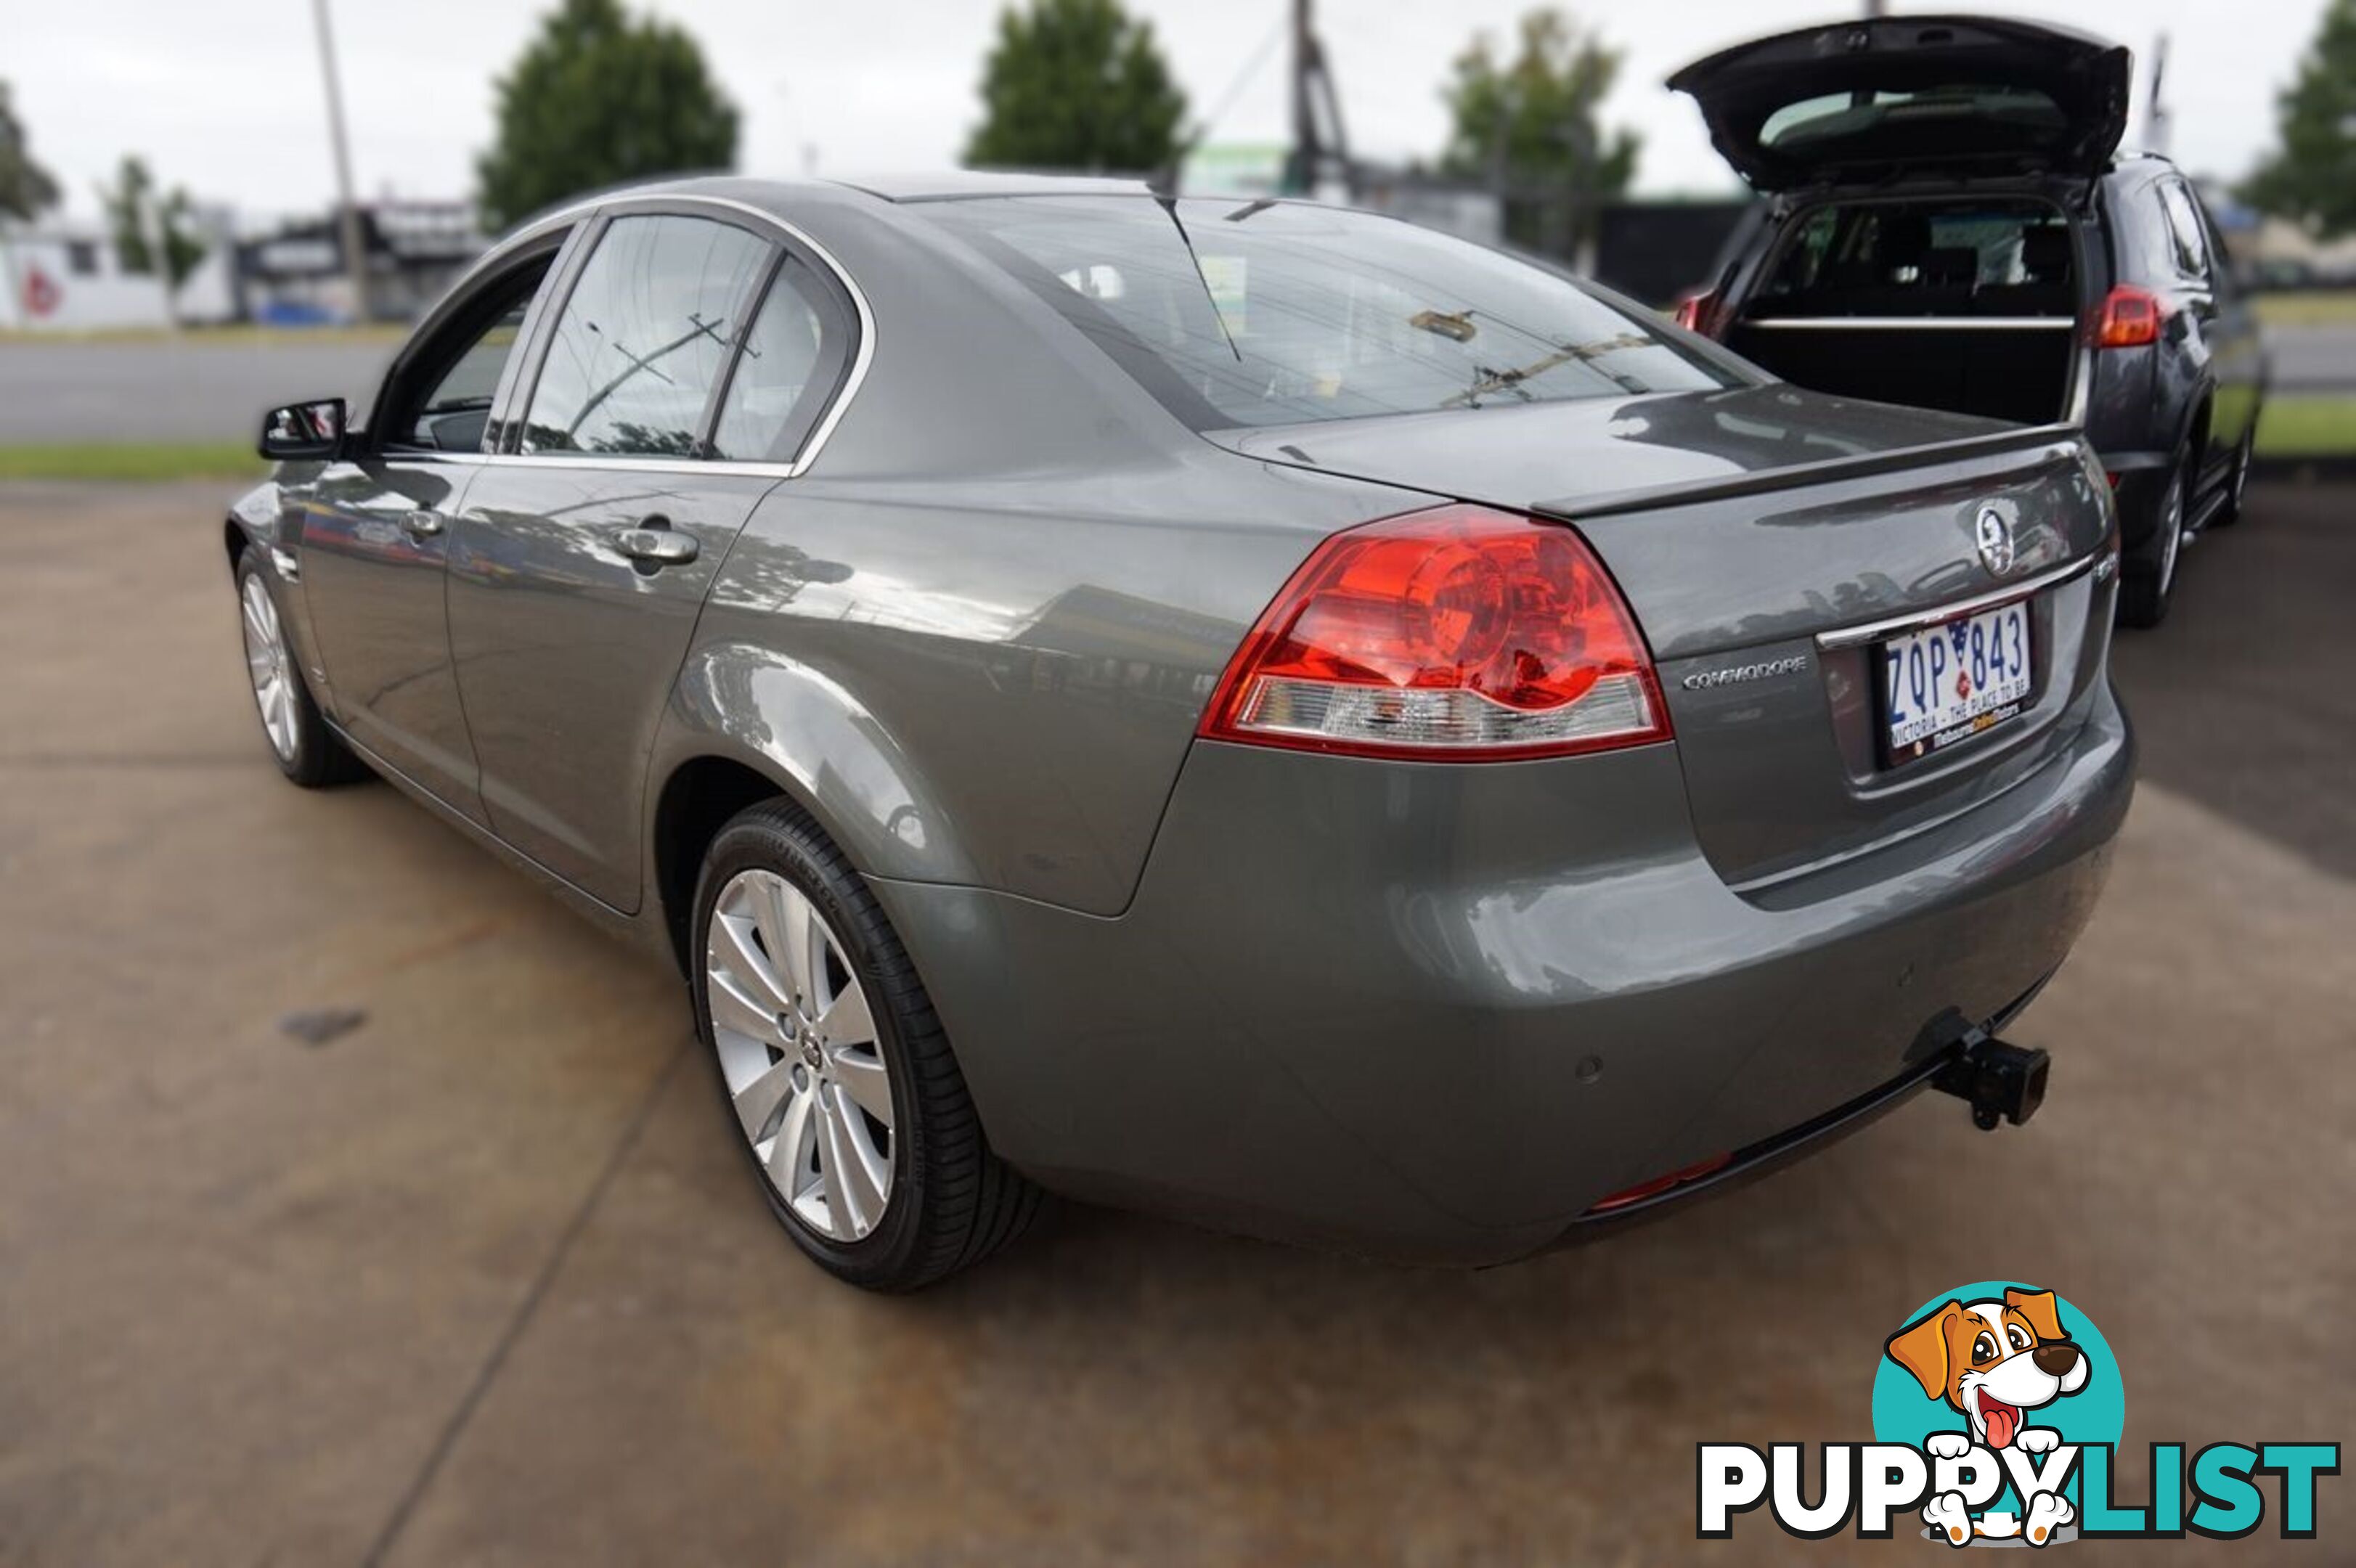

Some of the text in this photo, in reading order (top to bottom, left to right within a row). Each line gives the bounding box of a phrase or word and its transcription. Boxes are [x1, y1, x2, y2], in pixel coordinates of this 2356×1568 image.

[1682, 656, 1807, 690] COMMODORE
[1888, 611, 2022, 724] ZQP 843
[1892, 715, 1936, 746] VICTORIA
[1950, 702, 1967, 721] THE
[1971, 690, 1997, 714] PLACE
[2000, 684, 2011, 701] TO
[2015, 679, 2026, 696] BE
